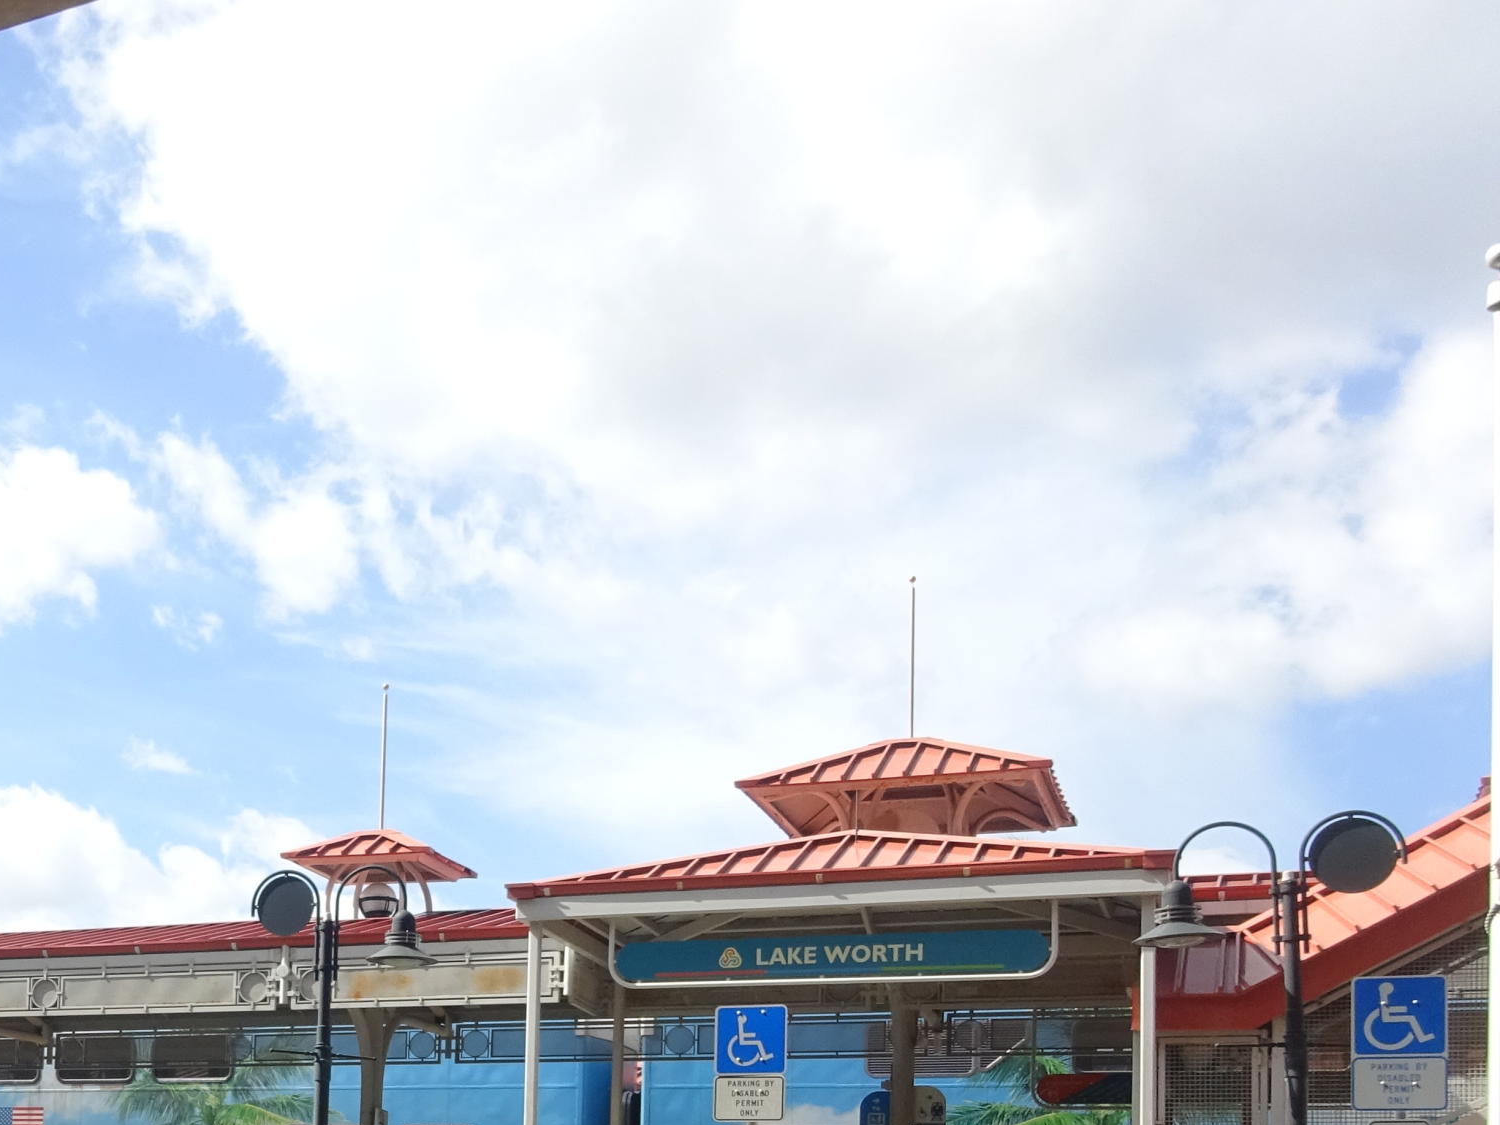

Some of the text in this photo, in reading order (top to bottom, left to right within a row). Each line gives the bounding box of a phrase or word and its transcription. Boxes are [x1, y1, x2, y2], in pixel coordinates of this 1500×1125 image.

[755, 943, 924, 966] LAKE WORTH
[1370, 1063, 1409, 1071] PARKING
